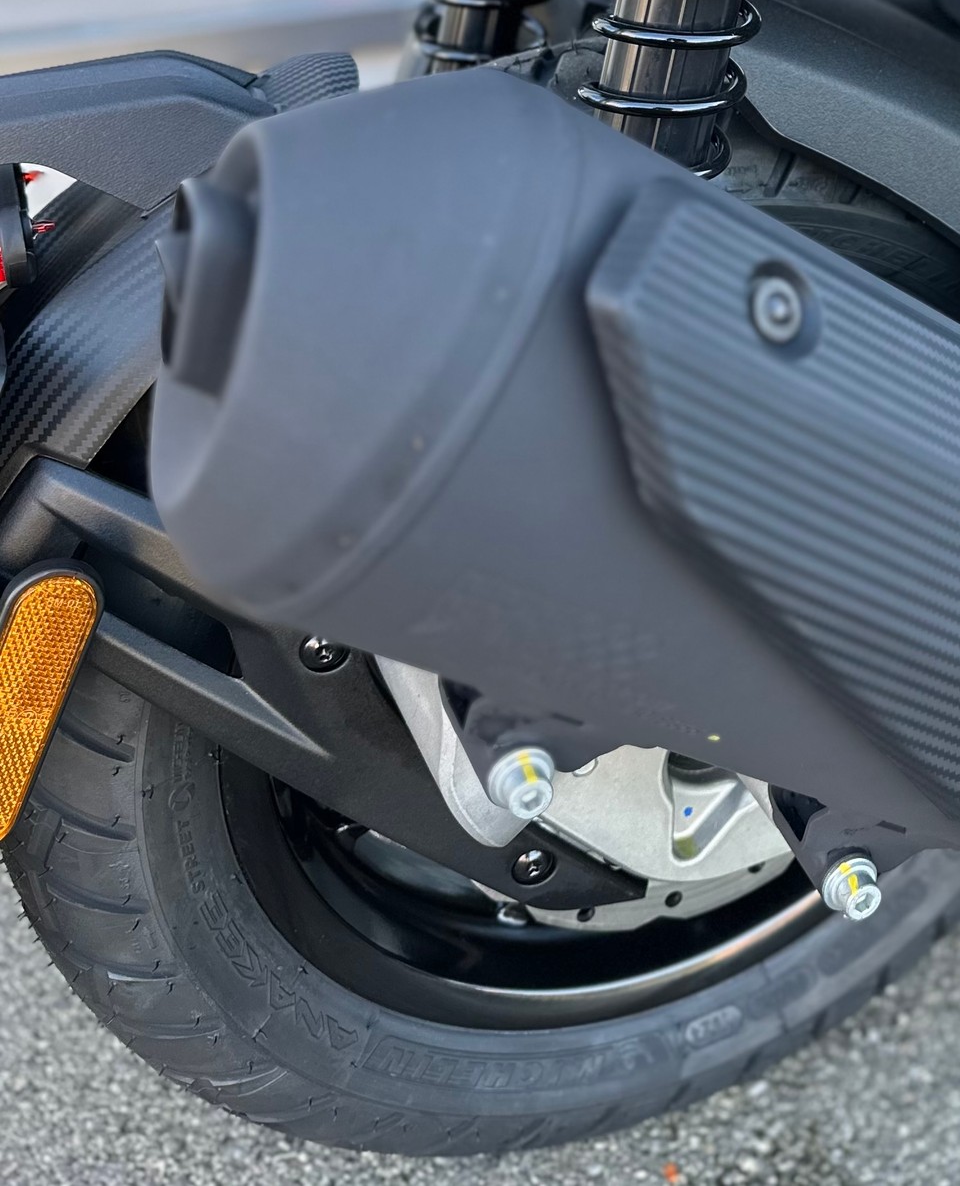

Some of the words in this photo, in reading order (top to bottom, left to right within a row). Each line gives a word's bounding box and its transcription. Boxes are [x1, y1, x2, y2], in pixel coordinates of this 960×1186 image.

[175, 820, 206, 894] STREET
[200, 890, 359, 1051] ANAKEE
[379, 1046, 606, 1089] MICHELIN
